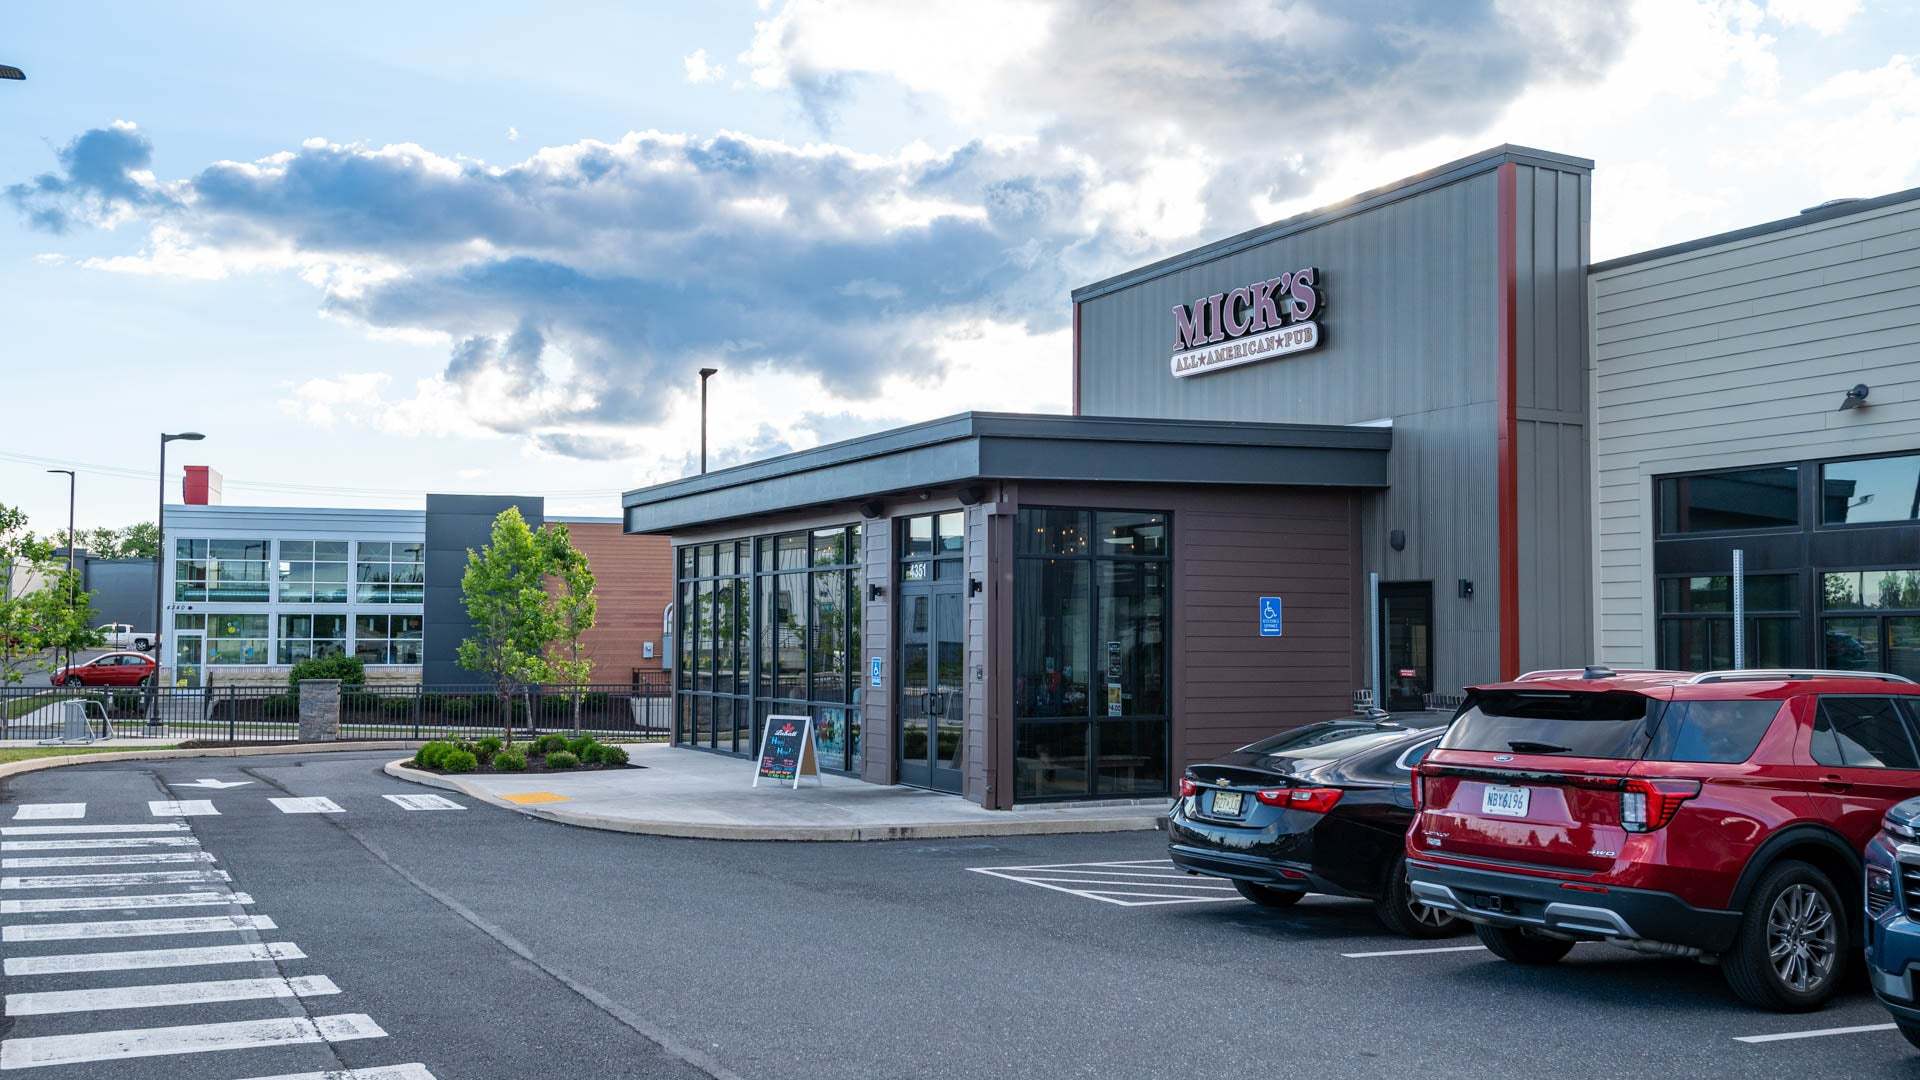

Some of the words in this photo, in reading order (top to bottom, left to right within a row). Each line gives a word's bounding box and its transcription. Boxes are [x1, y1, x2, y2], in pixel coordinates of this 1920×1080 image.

[1172, 267, 1316, 350] MICK'S
[1175, 355, 1200, 372] ALL
[1206, 335, 1276, 365] AMERICAN
[1284, 327, 1313, 346] PUB
[910, 563, 927, 578] 4351
[1488, 792, 1523, 809] NBY6196
